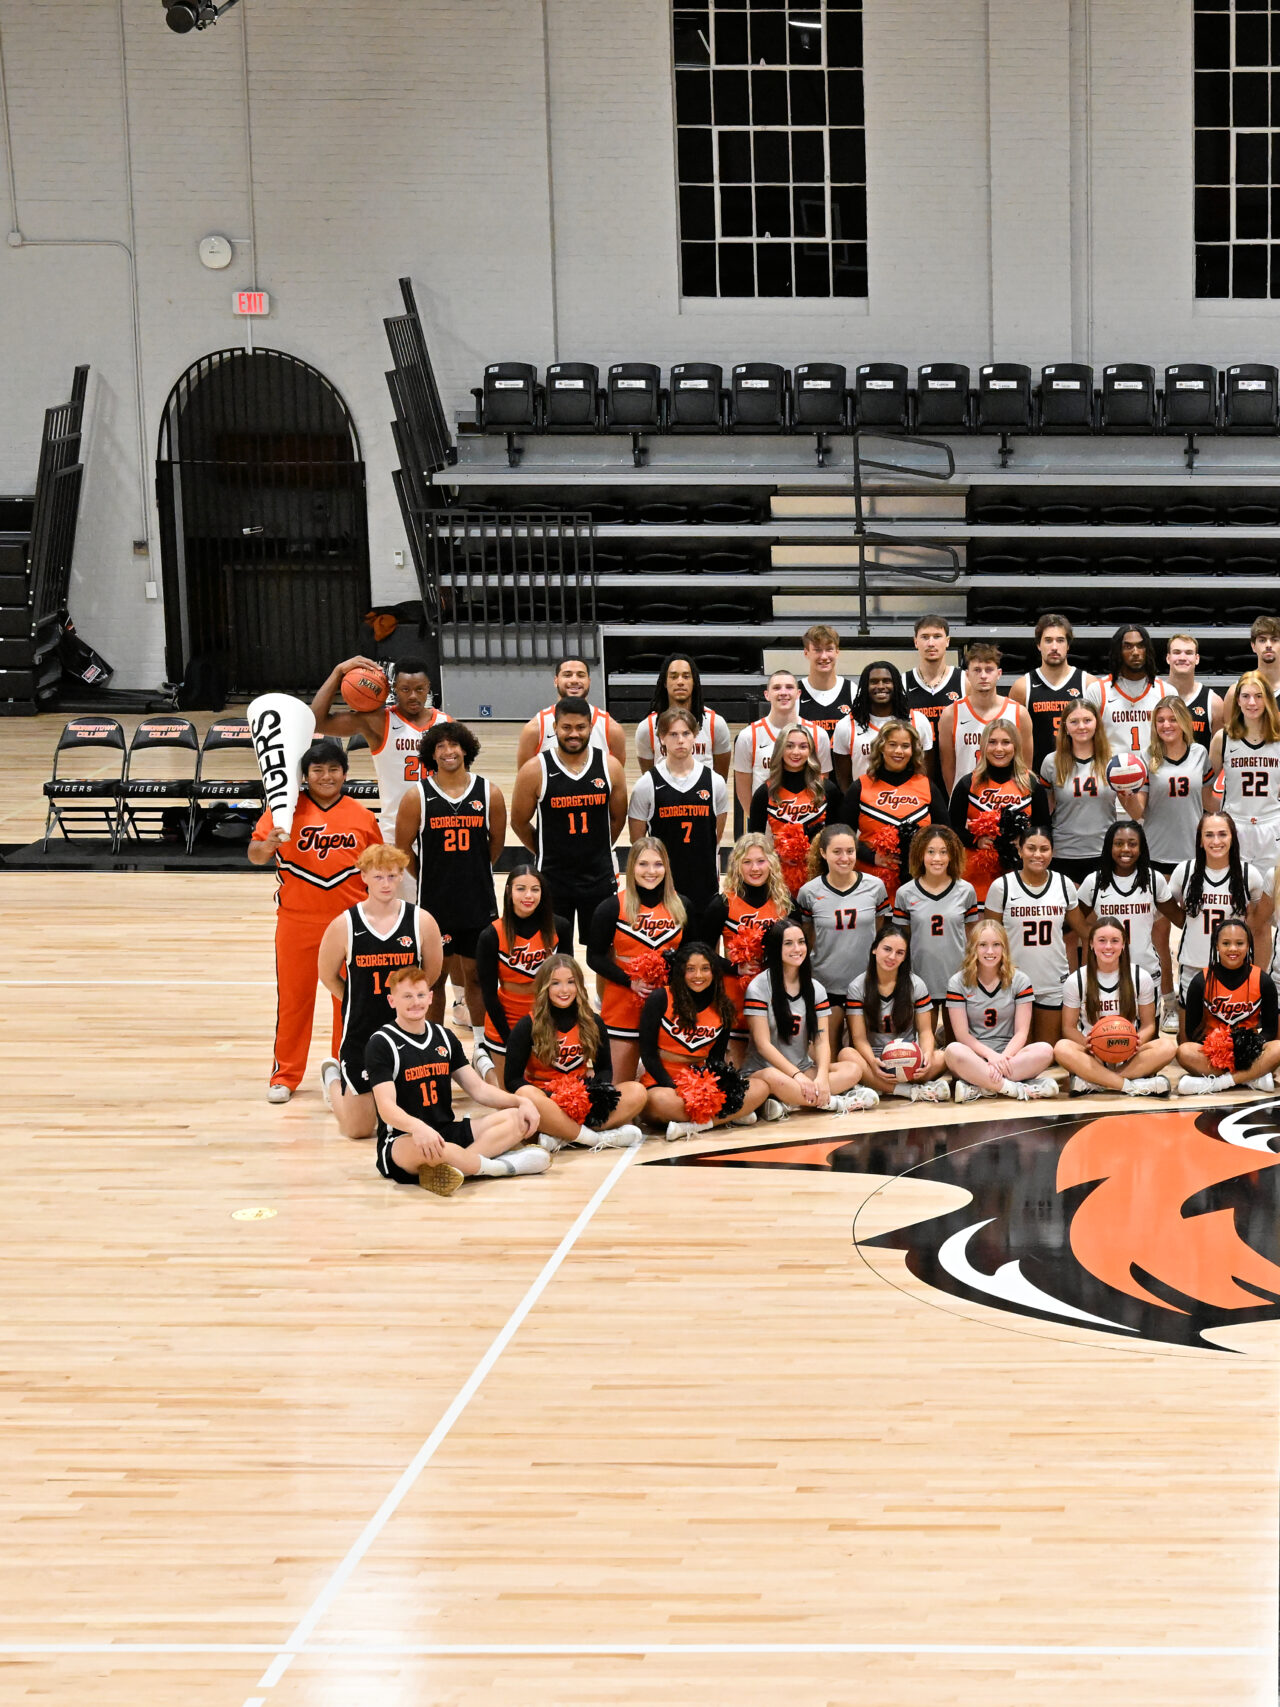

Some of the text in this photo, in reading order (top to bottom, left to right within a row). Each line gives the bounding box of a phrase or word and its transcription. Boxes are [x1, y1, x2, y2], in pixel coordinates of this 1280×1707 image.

[238, 293, 264, 313] EXIT
[1130, 727, 1141, 750] 1
[1230, 757, 1279, 769] GEORGETOWN
[128, 785, 167, 793] TIGERS
[201, 786, 240, 794] TIGERS
[347, 786, 379, 794] TIGER
[1073, 777, 1098, 798] 14
[1168, 777, 1190, 798] 13
[1241, 771, 1269, 798] 22
[550, 793, 607, 809] GEORGETOWN
[776, 797, 819, 824] Tigers
[877, 789, 919, 810] Tigers
[979, 788, 1022, 812] Tigers
[430, 815, 484, 830] GEORGETOWN
[659, 804, 710, 819] GEORGETOWN
[567, 812, 589, 835] 11
[680, 821, 693, 843] 7
[297, 823, 357, 860] Tigers
[444, 829, 470, 852] 20
[834, 908, 857, 931] 17
[1010, 905, 1064, 918] GEORGETOWN
[1100, 902, 1151, 916] GEORGETOWN
[631, 911, 676, 937] Tigers
[931, 914, 944, 936] 2
[1203, 909, 1225, 935] 12
[1022, 920, 1053, 947] 20
[355, 952, 415, 968] GEORGETOWN
[508, 943, 548, 972] Tiger
[1210, 993, 1254, 1020] Tigers
[984, 1008, 998, 1028] 3
[419, 1080, 439, 1107] 16
